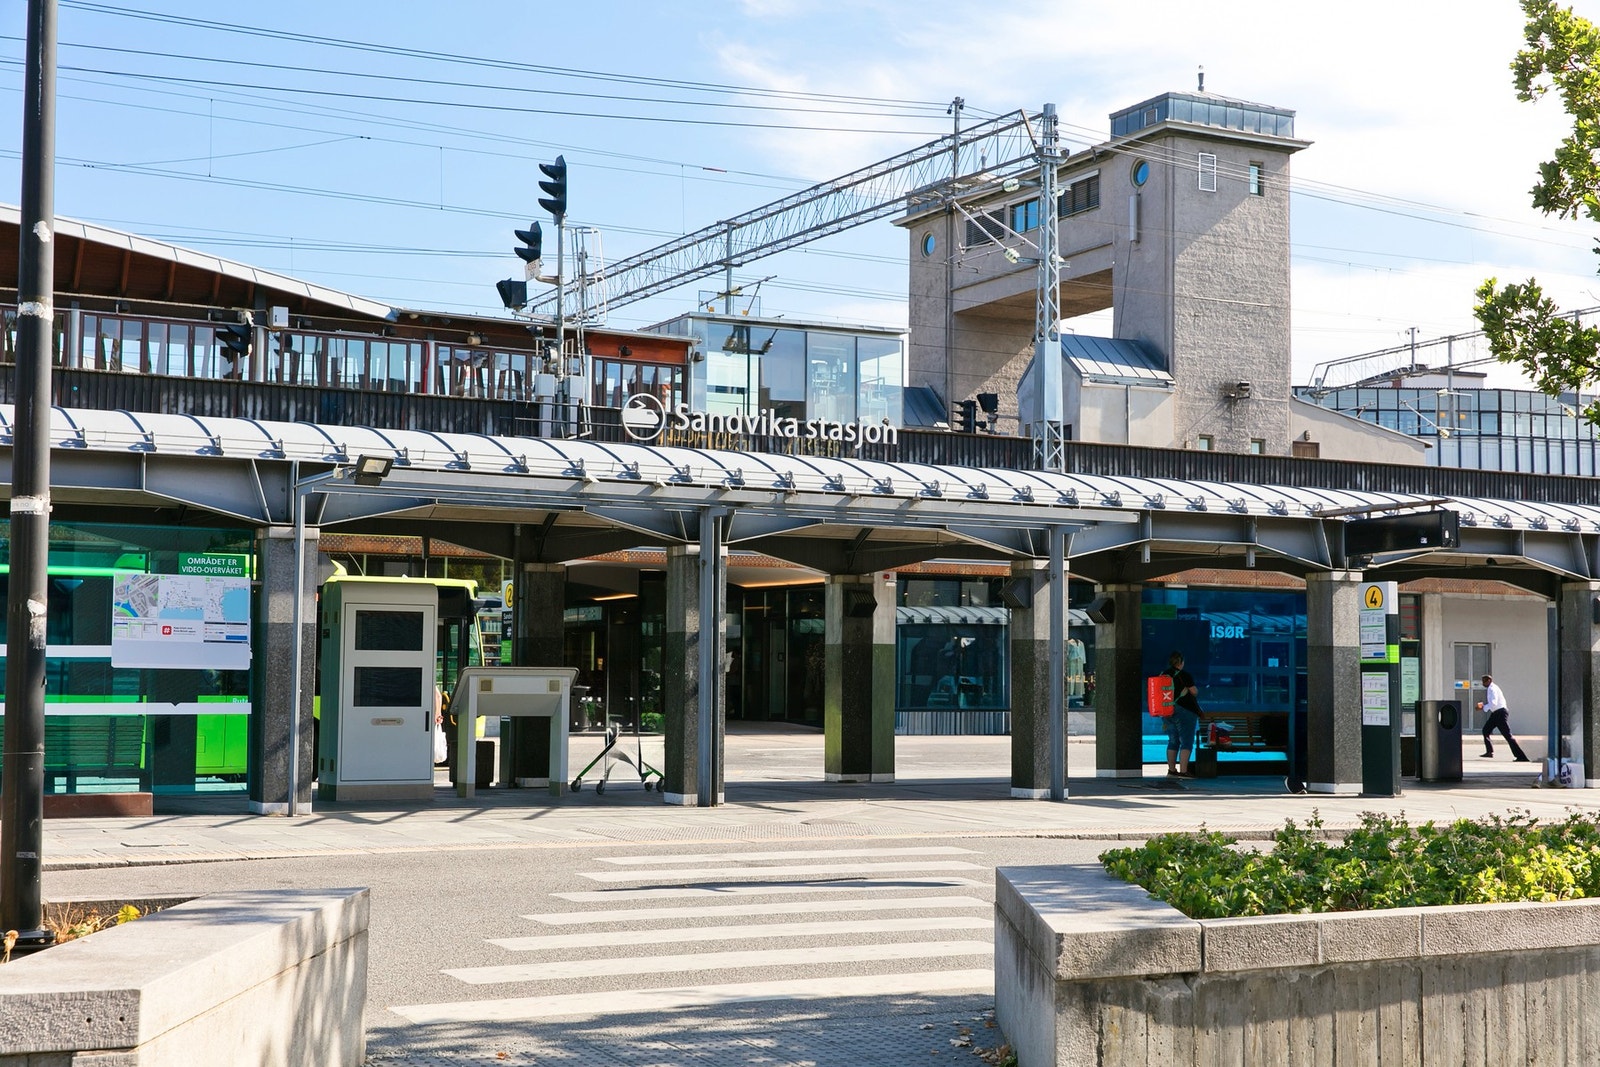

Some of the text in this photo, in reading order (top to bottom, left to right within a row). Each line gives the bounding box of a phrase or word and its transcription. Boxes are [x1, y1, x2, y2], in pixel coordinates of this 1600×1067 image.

[674, 403, 799, 438] Sandvika
[805, 417, 898, 449] stasjon
[187, 556, 237, 566] OMRÅDET ER
[181, 565, 243, 575] VIDEO-OVERVÅKET
[507, 588, 512, 603] 2
[1369, 590, 1378, 606] 4
[1210, 625, 1245, 639] ISØR
